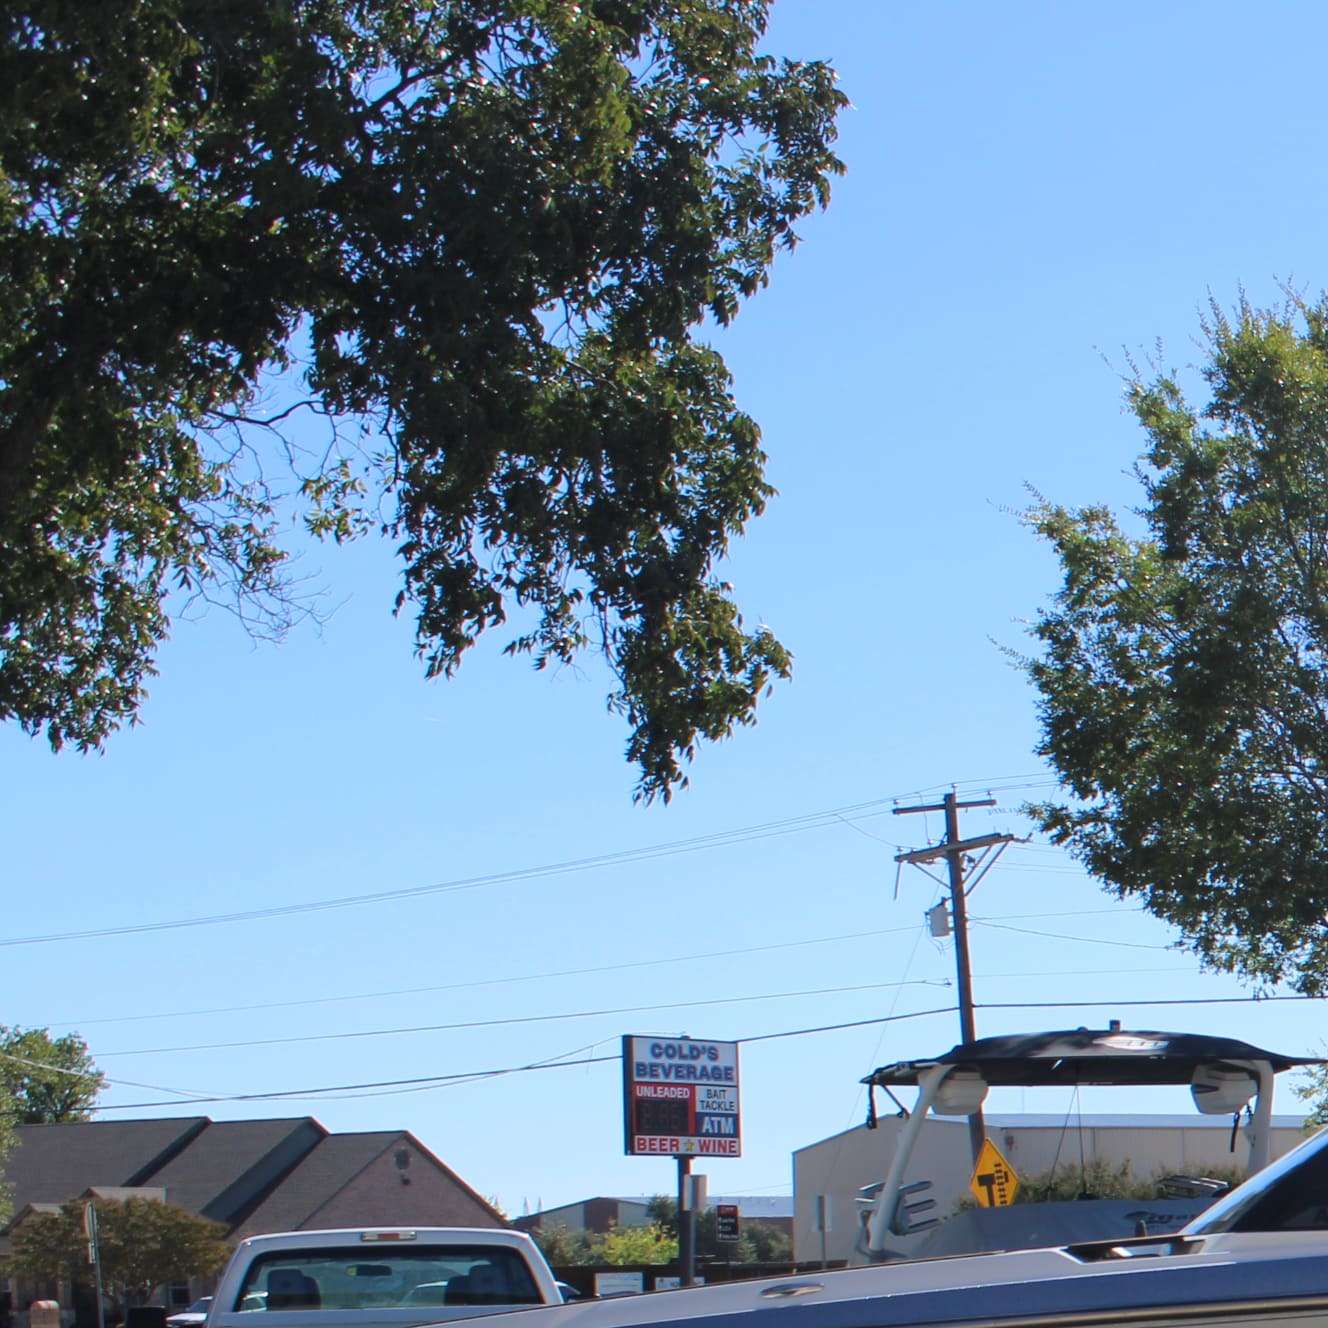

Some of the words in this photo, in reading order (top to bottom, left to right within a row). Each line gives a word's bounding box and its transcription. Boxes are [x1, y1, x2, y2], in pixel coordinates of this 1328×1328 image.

[650, 1042, 719, 1061] COLD'S
[635, 1062, 735, 1081] BEVERAGE
[636, 1085, 690, 1099] UNLEADED
[706, 1088, 727, 1099] BAIT
[700, 1100, 735, 1111] TACKLE
[702, 1116, 734, 1134] ATM
[636, 1138, 680, 1152] BEER
[698, 1138, 737, 1153] WINE
